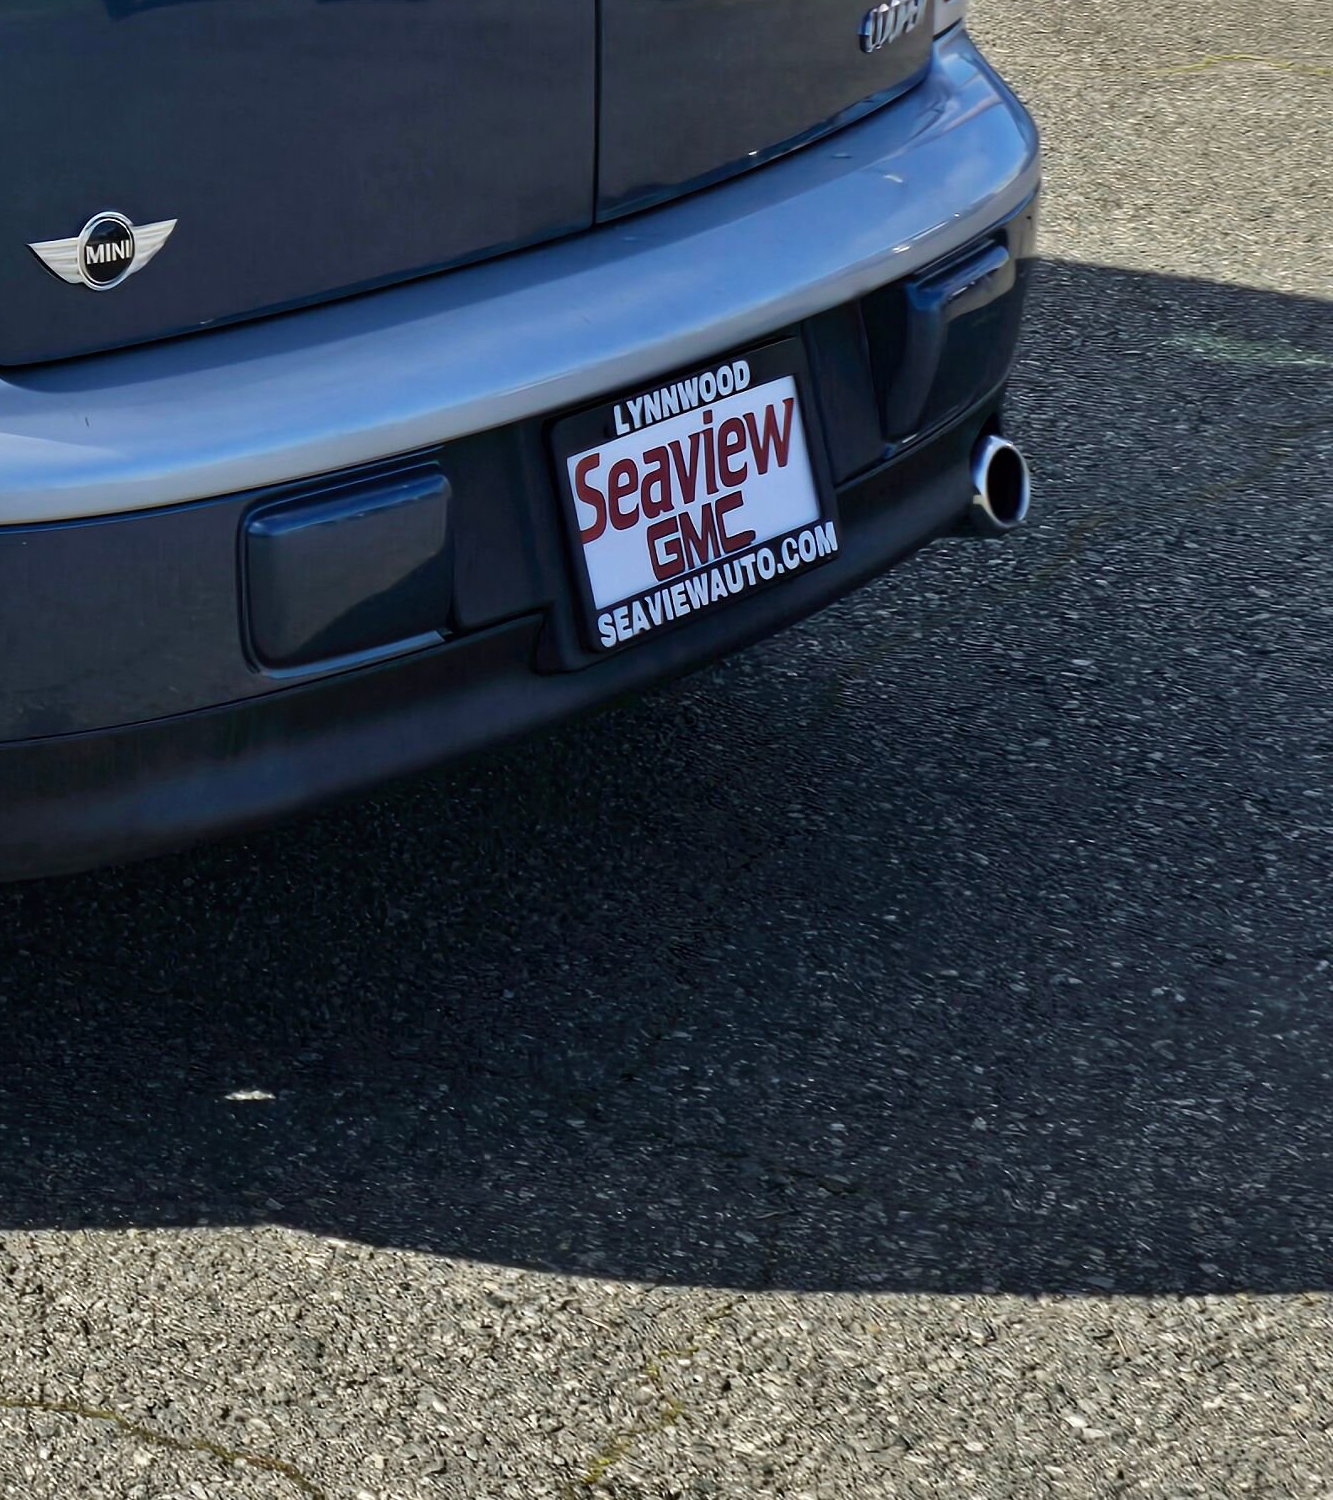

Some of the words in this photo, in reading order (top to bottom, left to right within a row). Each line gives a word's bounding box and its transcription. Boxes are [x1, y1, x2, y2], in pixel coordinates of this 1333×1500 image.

[86, 239, 131, 265] MINI
[613, 360, 751, 436] LYNNWOOD
[575, 397, 795, 545] Seaview
[646, 490, 757, 582] GMC
[597, 521, 838, 649] SEAVIEWAUTO.COM
